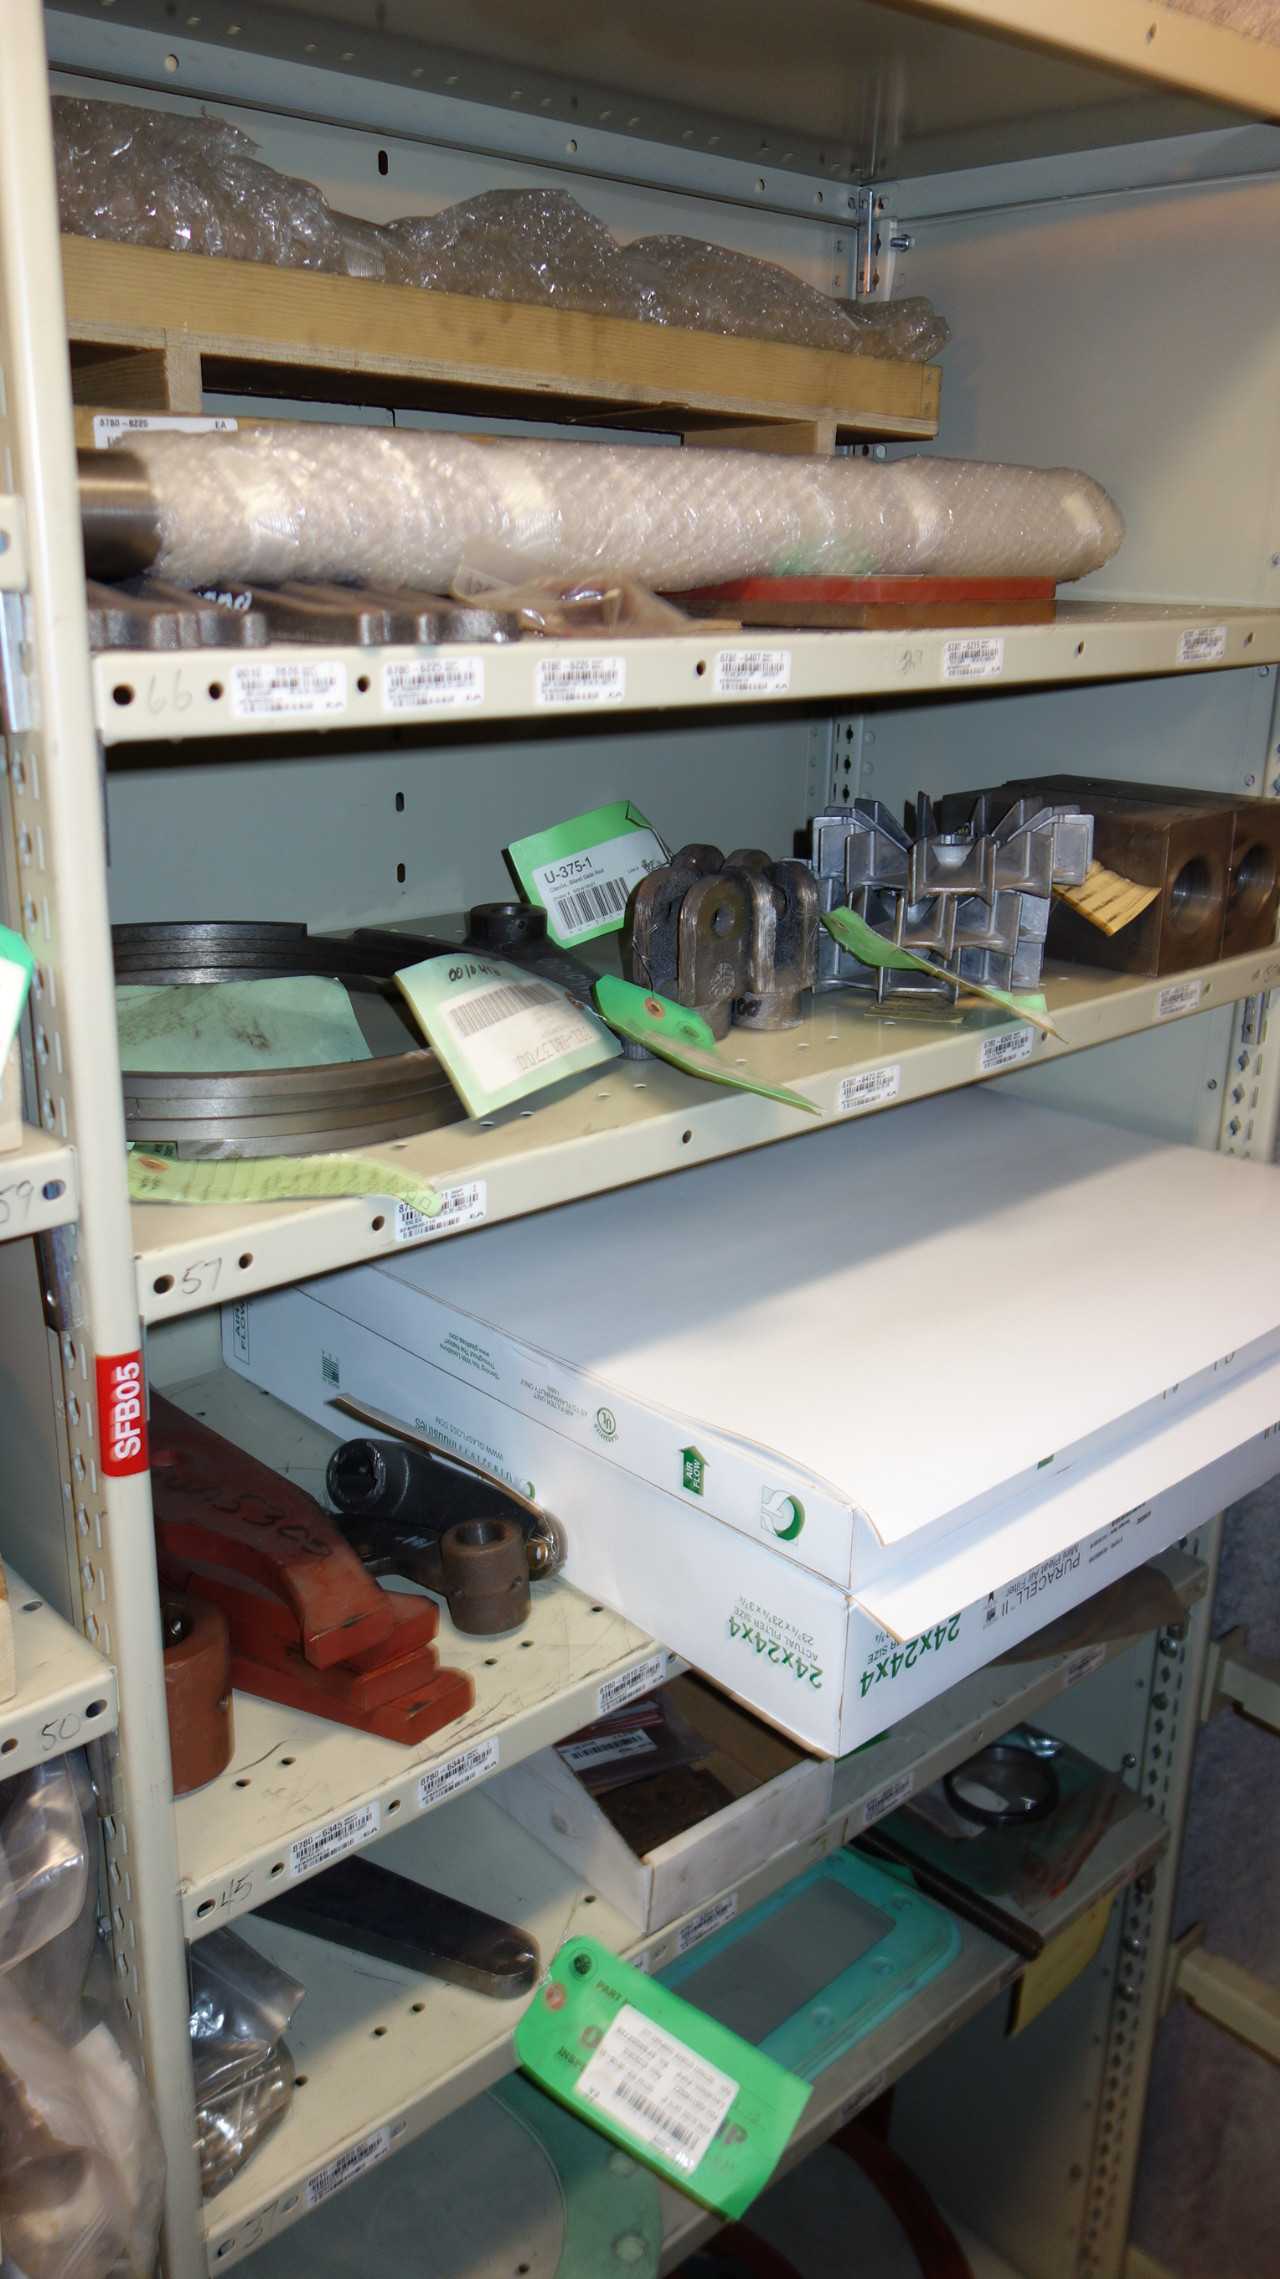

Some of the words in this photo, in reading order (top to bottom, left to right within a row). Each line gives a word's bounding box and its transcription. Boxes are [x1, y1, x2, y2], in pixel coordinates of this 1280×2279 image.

[544, 857, 593, 884] U-375-1
[181, 1258, 224, 1294] 57
[113, 1361, 141, 1462] SFB05
[686, 1461, 694, 1480] AIR
[692, 1459, 702, 1490] FLOW
[1017, 1557, 1081, 1604] PURACELL
[728, 1616, 824, 1690] 24x24x4
[860, 1612, 961, 1698] 24x24x4
[41, 1714, 81, 1750] 50
